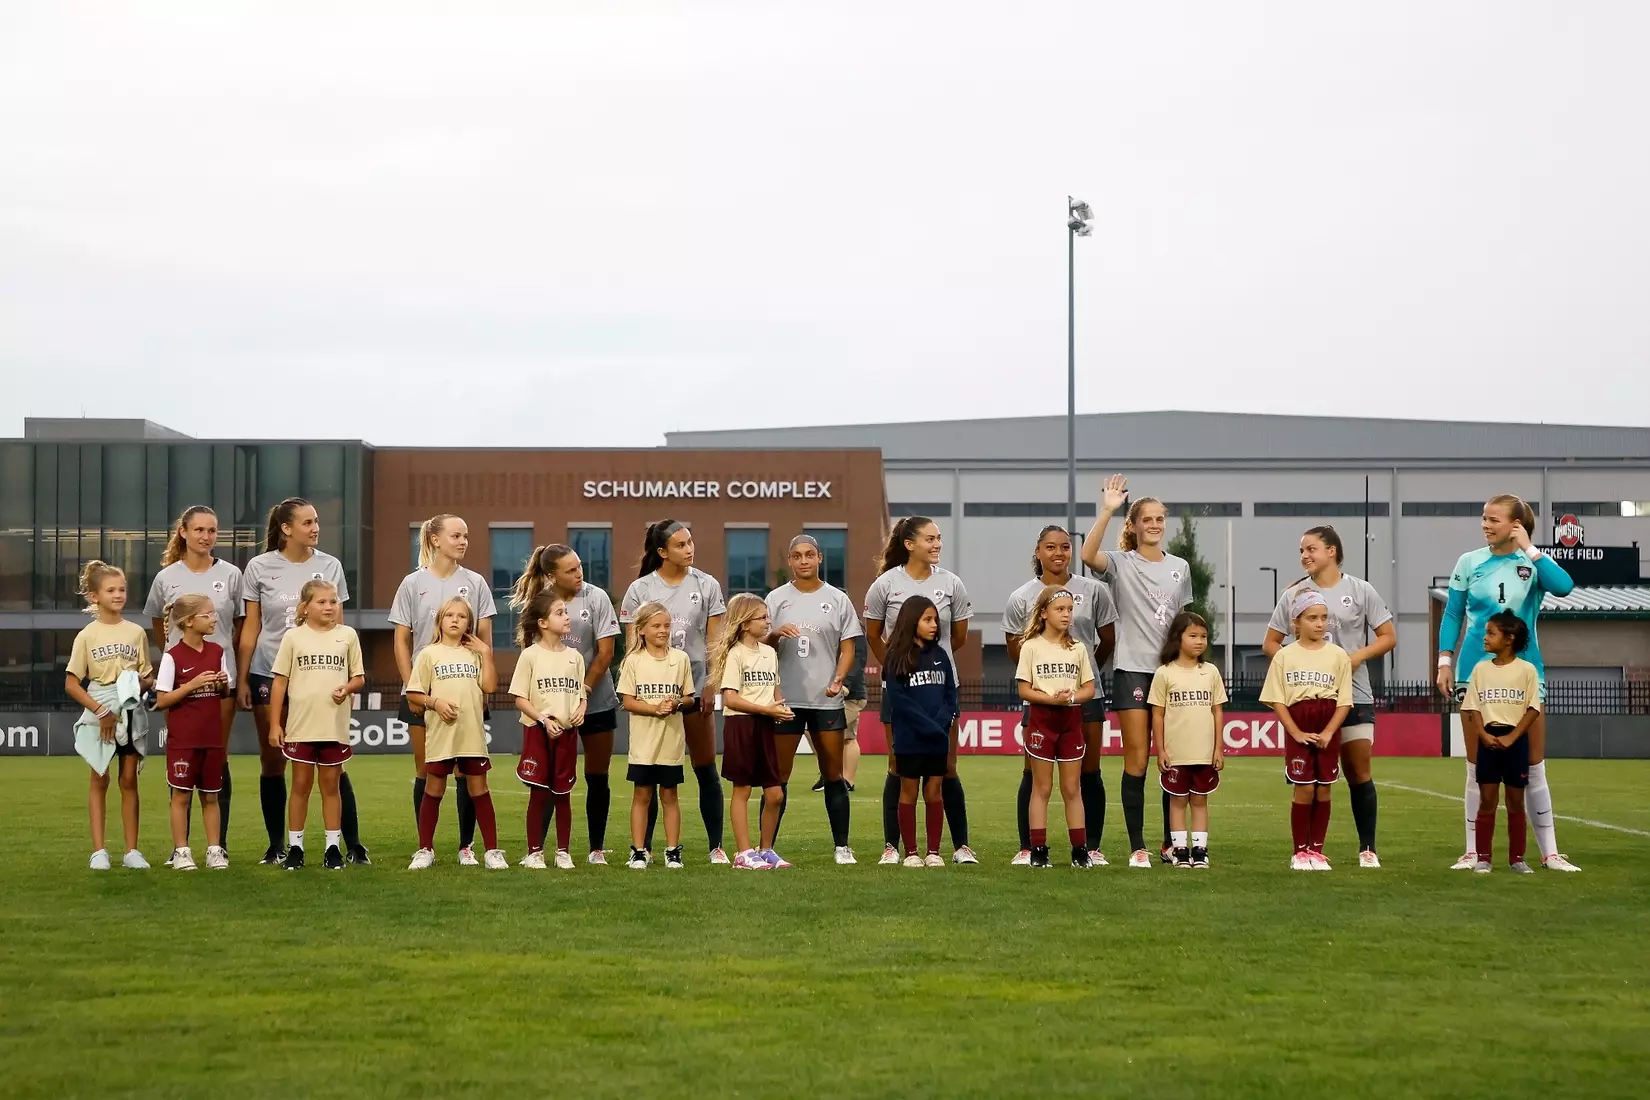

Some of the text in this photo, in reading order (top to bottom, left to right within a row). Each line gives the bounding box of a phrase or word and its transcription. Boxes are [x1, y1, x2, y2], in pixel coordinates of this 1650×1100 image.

[583, 480, 832, 498] SCHUMAKER COMPLEX
[1538, 547, 1604, 560] CKEYE FIELD
[1498, 582, 1506, 604] 1
[1154, 604, 1167, 626] 4
[91, 643, 138, 659] FREEDOM
[797, 635, 810, 658] 9
[297, 654, 346, 667] FREEDOM
[741, 671, 777, 682] REEDO
[909, 670, 947, 687] REEDO
[1286, 671, 1336, 686] FREEDOM
[1169, 690, 1213, 702] FREEDO
[1478, 688, 1525, 702] FEEDOM
